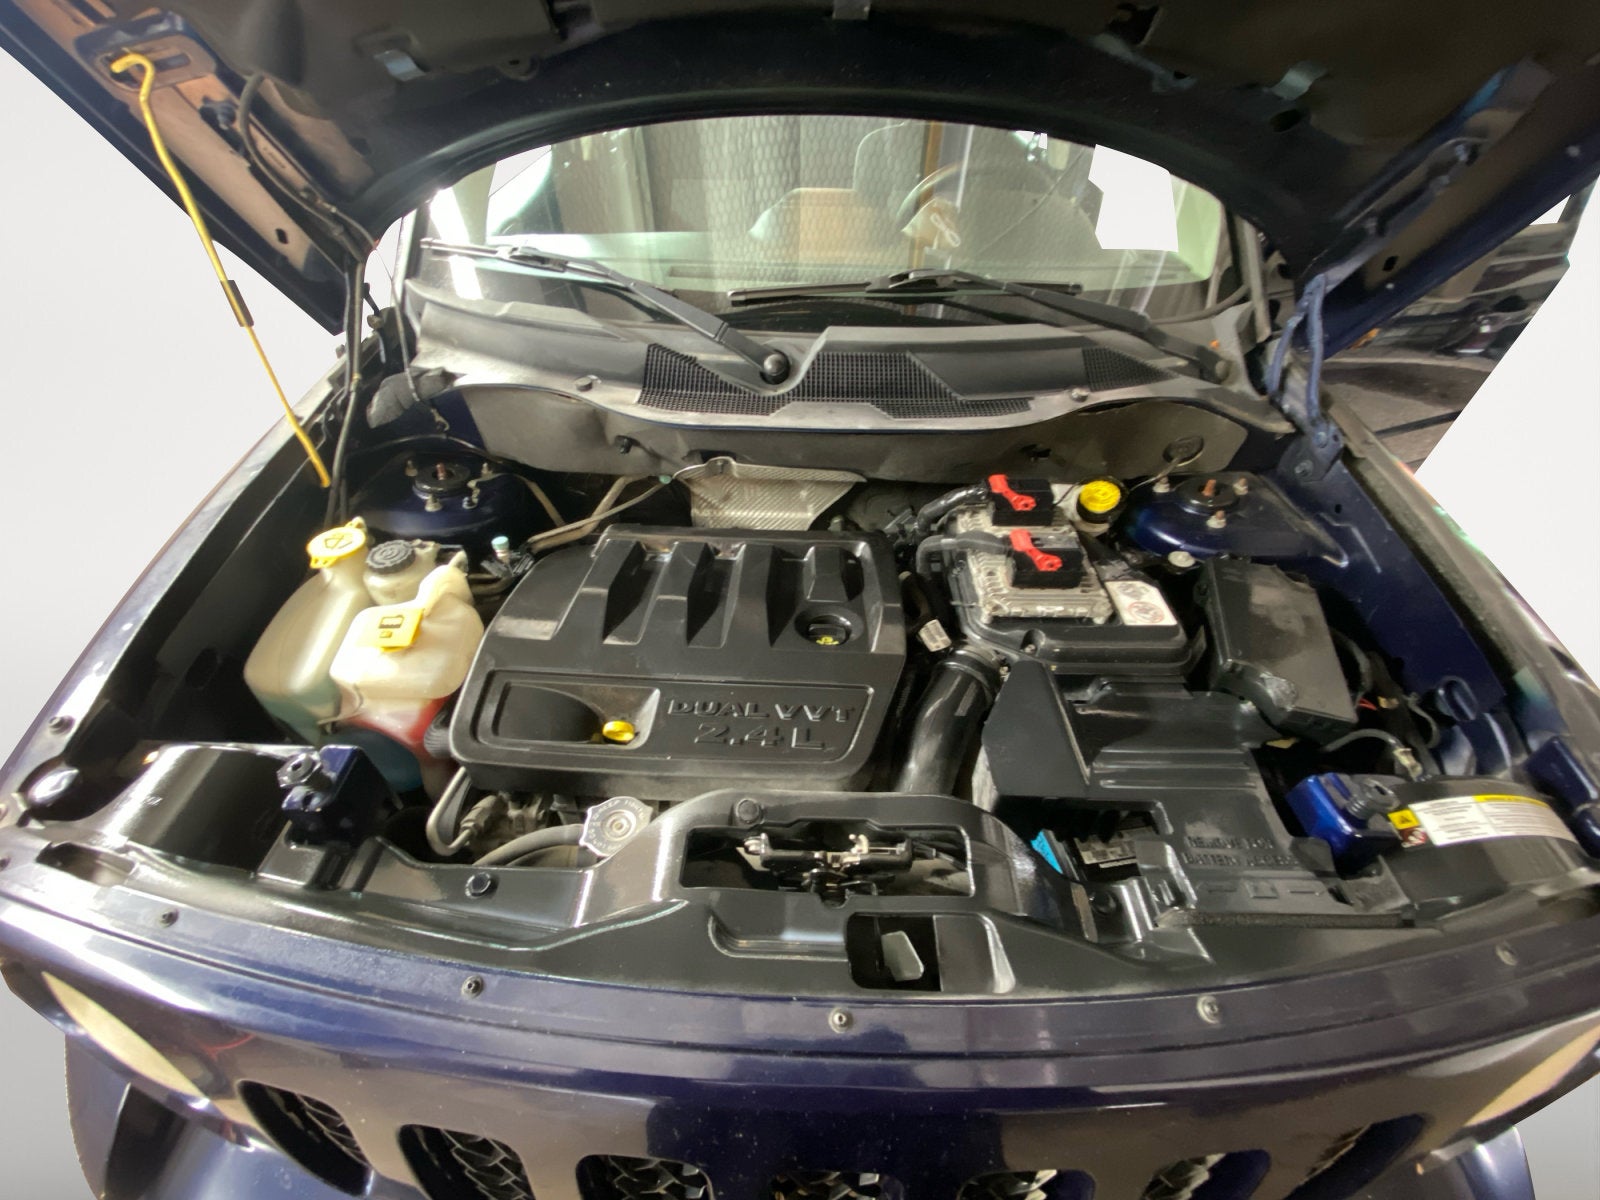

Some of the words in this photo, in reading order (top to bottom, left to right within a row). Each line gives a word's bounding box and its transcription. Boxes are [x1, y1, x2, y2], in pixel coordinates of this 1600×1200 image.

[667, 699, 770, 719] DUAL
[774, 703, 856, 722] VVT
[694, 722, 826, 750] 2.4L
